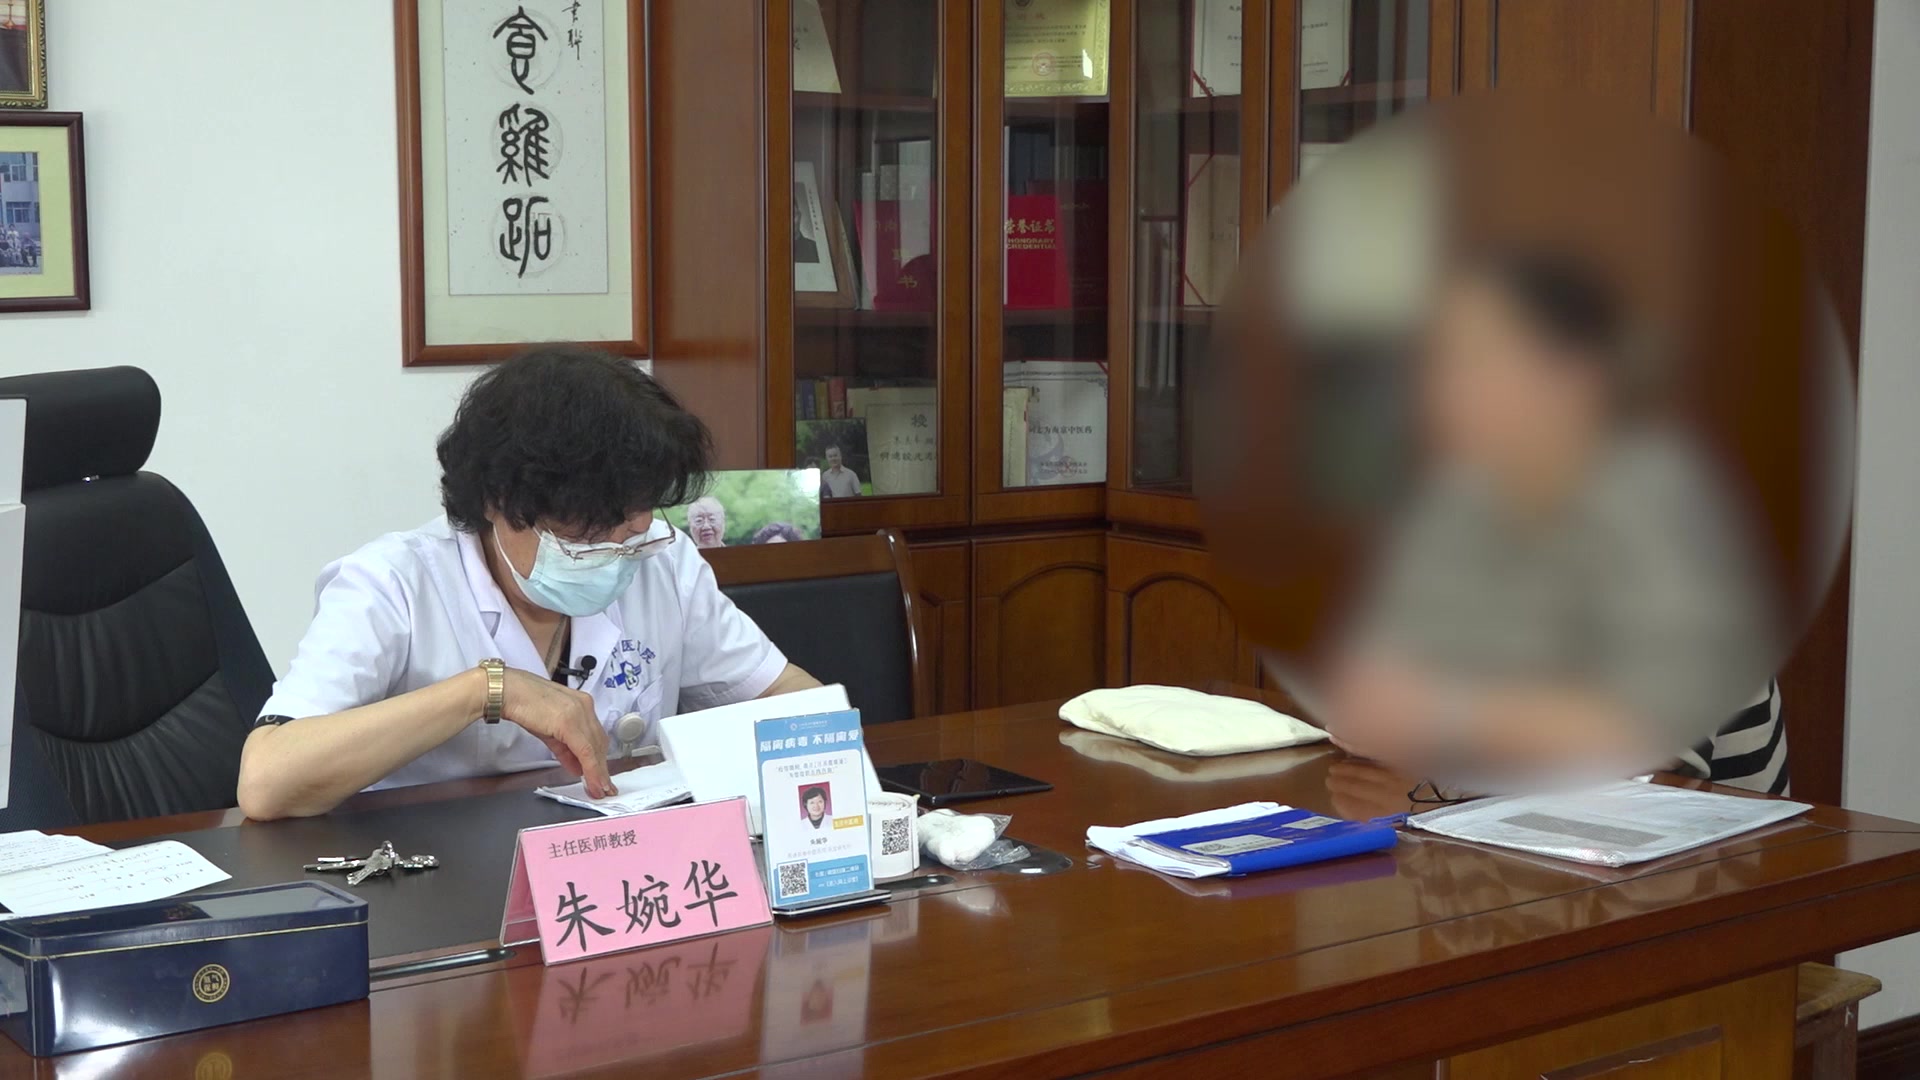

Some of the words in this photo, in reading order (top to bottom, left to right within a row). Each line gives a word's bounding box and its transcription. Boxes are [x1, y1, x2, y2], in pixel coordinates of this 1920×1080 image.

[1005, 217, 1055, 234] 荣誉证书
[760, 736, 808, 752] 隔离病毒
[812, 729, 860, 745] 不隔离爱
[548, 829, 638, 859] 主任医师教授
[555, 859, 739, 952] 朱婉华
